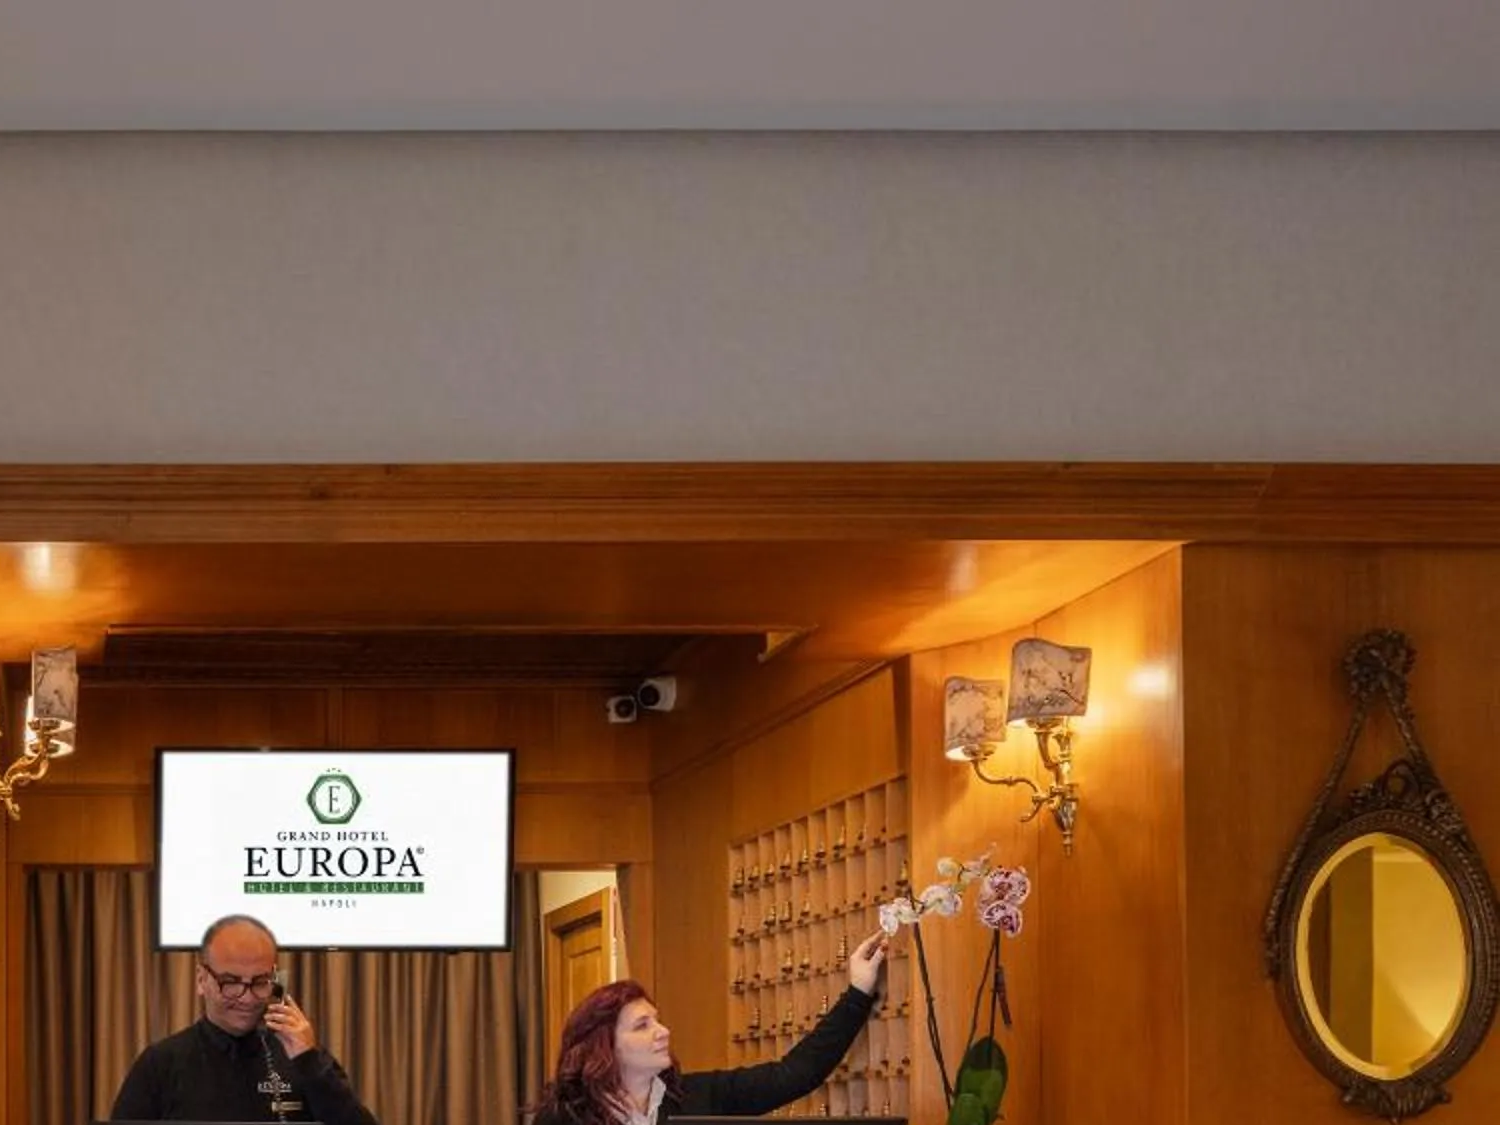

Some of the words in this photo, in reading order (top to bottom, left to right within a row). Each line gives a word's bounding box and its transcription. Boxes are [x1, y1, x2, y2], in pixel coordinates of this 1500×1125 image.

[328, 785, 341, 813] E
[277, 831, 331, 842] GRAND
[337, 831, 389, 842] HOTEL
[311, 899, 357, 908] NAPOLI
